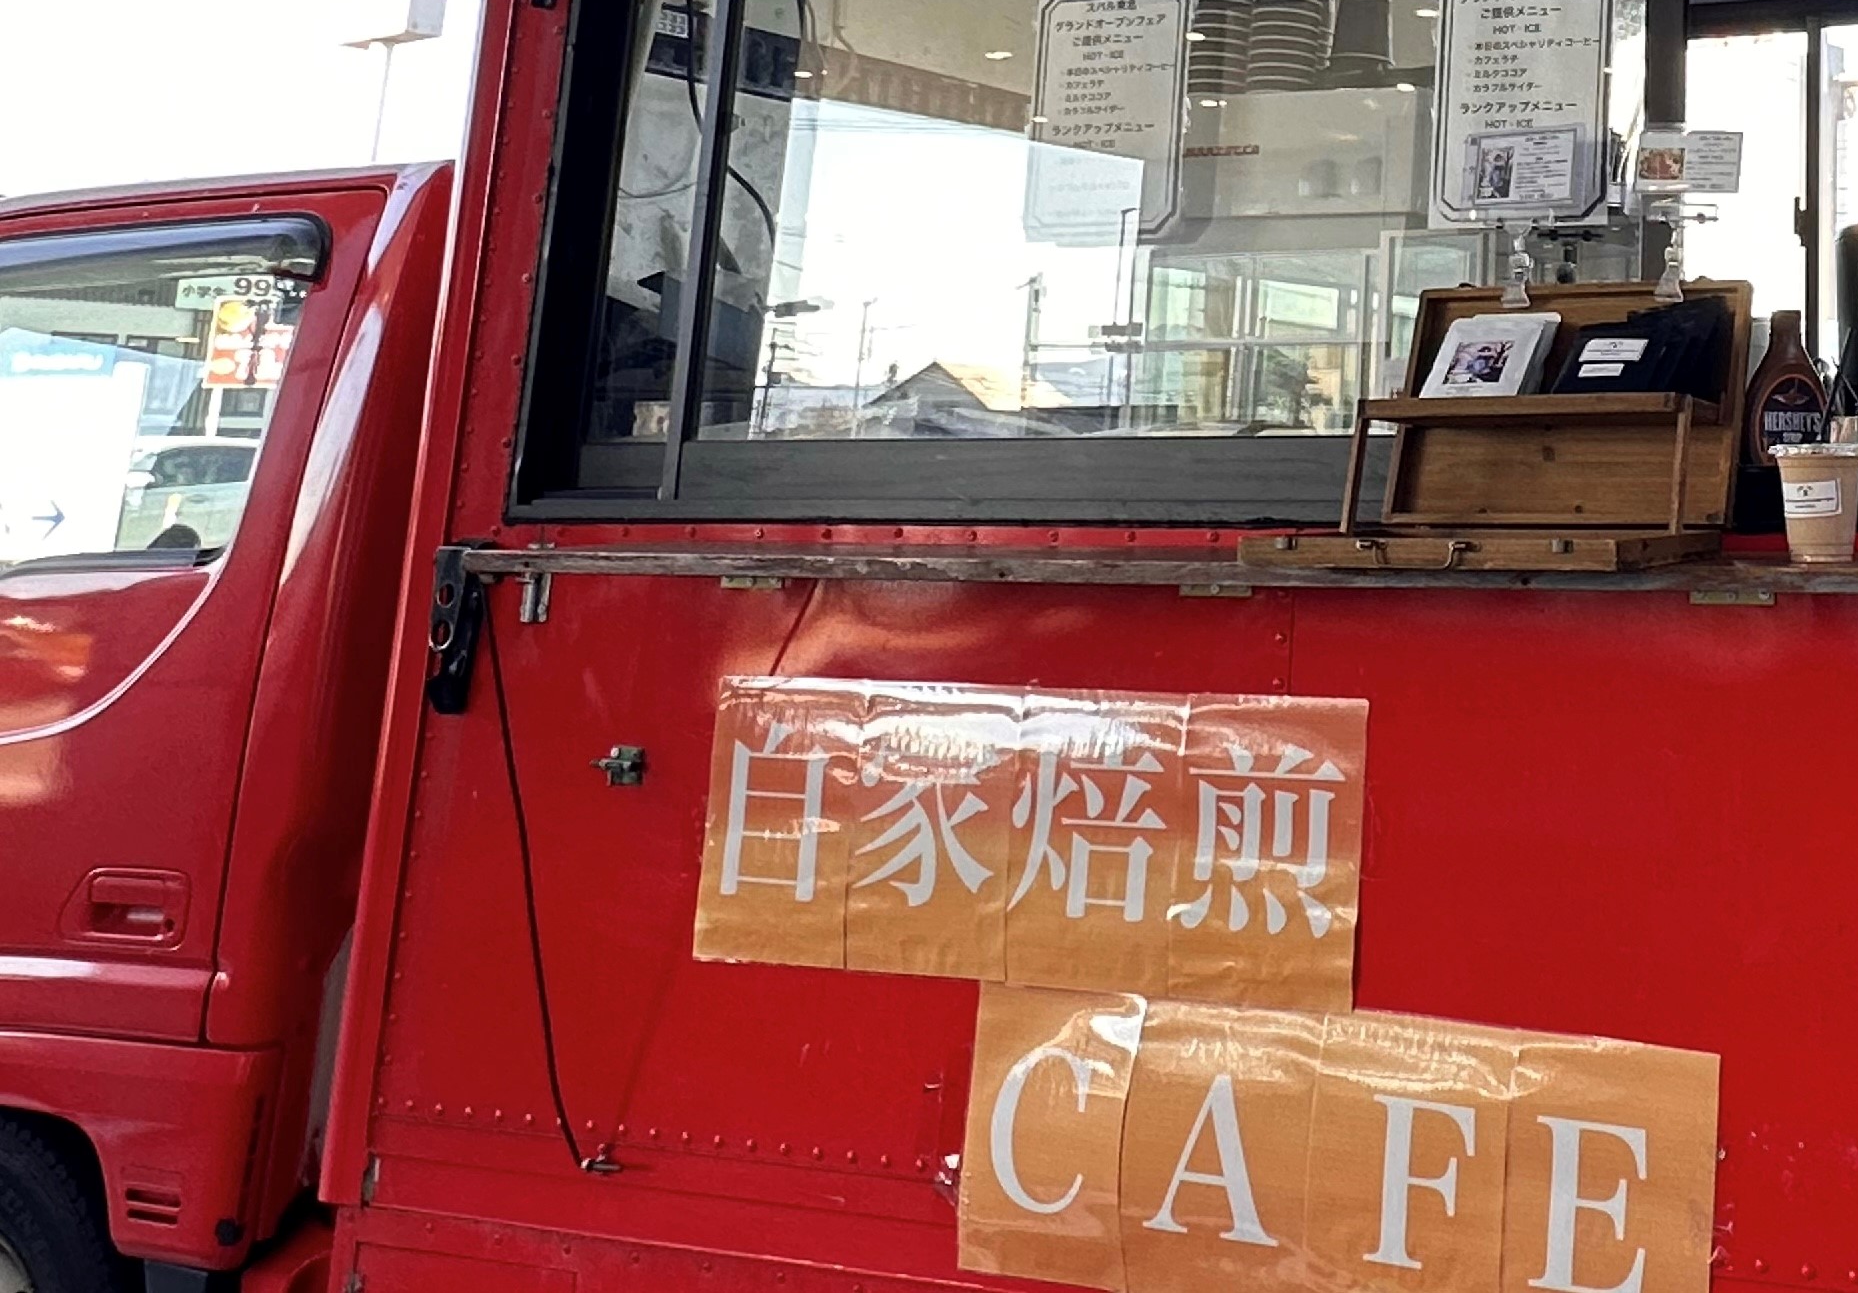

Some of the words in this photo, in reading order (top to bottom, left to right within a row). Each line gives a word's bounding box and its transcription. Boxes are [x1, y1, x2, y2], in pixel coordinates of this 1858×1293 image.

[1460, 101, 1578, 115] ランクアップメニュー
[718, 720, 1346, 939] 自家焙煎
[988, 1046, 1648, 1293] CAFE
